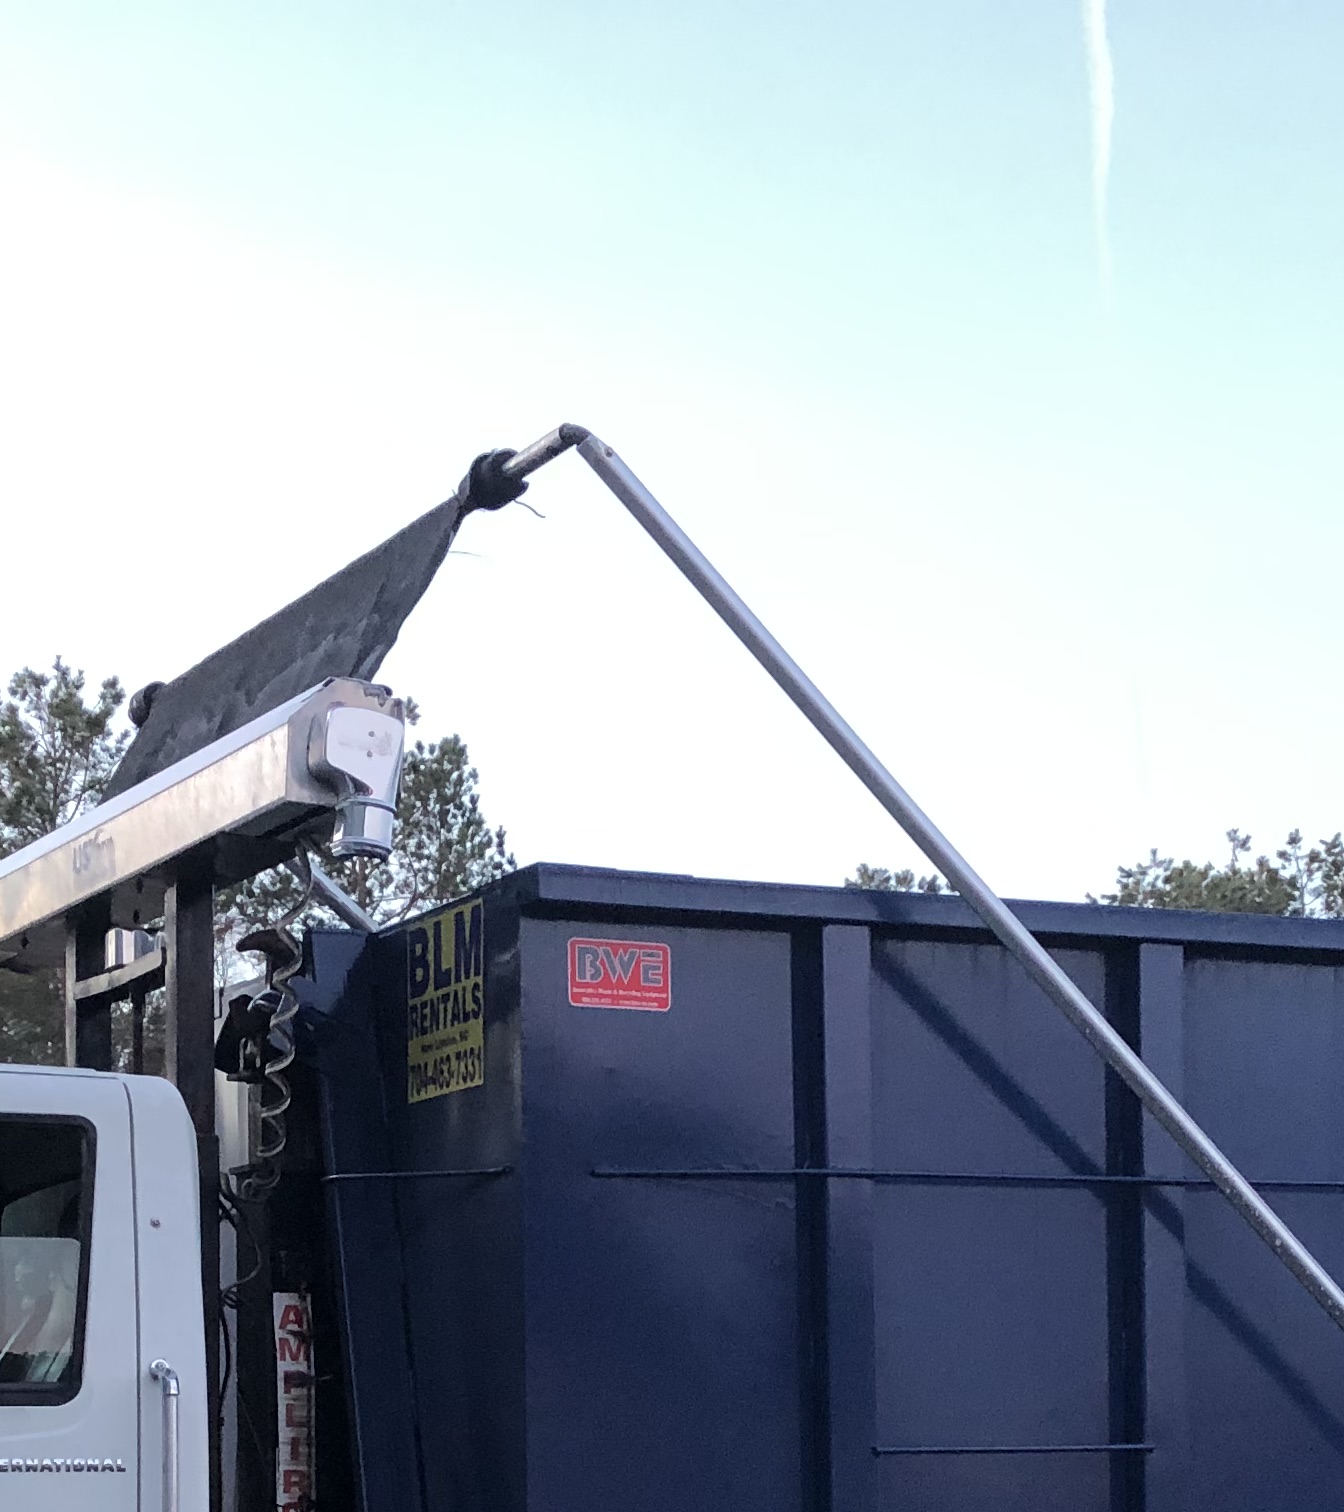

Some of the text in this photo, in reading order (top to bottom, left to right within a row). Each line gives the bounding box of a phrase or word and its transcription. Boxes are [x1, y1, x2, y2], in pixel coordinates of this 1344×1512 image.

[409, 904, 482, 999] BLM
[576, 945, 663, 987] BWE
[409, 982, 482, 1041] RENTALS
[410, 1045, 482, 1098] 704-463-7331
